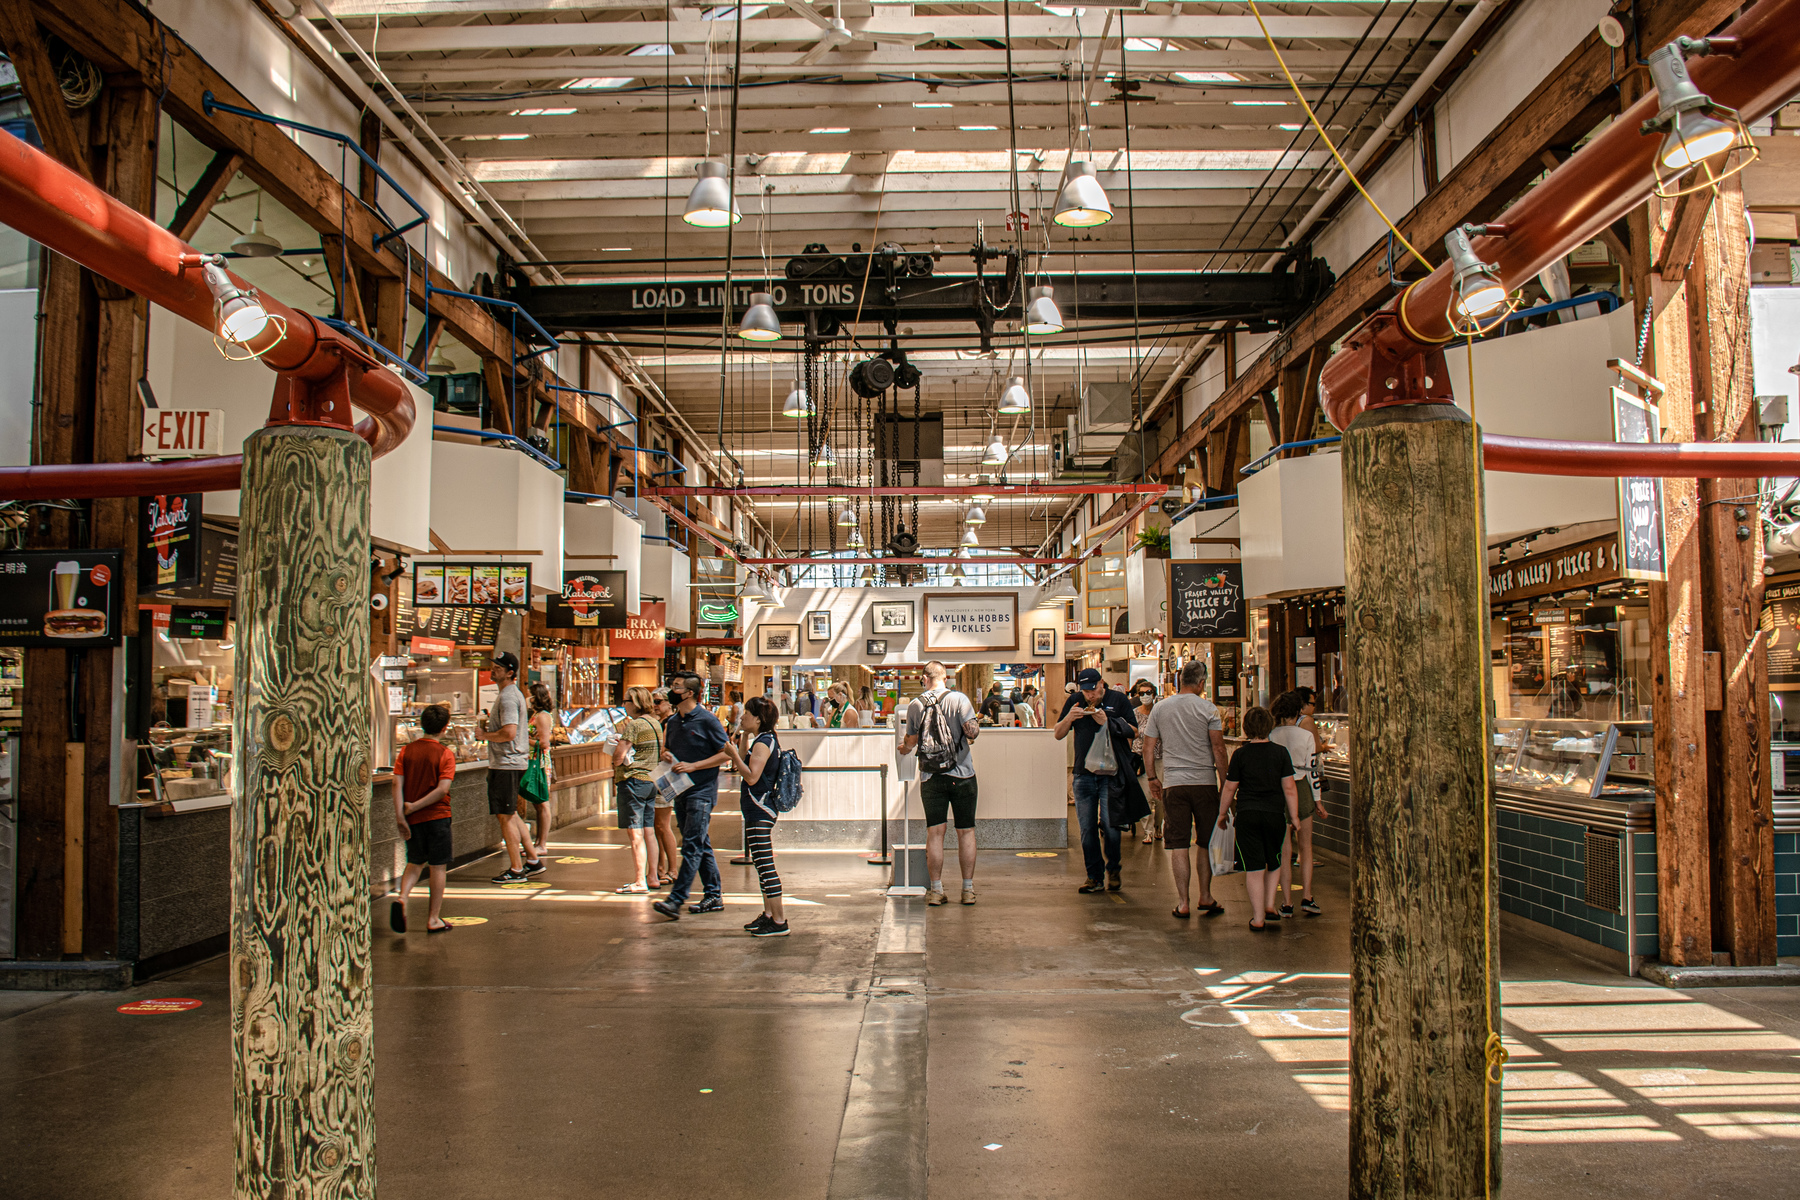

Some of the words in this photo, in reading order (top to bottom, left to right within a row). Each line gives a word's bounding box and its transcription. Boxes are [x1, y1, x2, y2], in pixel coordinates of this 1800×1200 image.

[632, 287, 686, 309] LOAD
[697, 287, 752, 307] LIMIT
[801, 284, 855, 305] TONS
[158, 411, 210, 450] EXIT
[1517, 562, 1551, 587] VALLEY
[1557, 551, 1591, 580] JUICE
[1597, 546, 1605, 569] &
[561, 583, 614, 599] Kaisereck
[1184, 589, 1208, 599] FRASER
[1209, 588, 1233, 596] VALLEY
[1185, 597, 1219, 610] JUICE
[1223, 596, 1230, 606] &
[933, 614, 966, 623] KAYLIN
[978, 614, 1010, 622] HOBBS
[1186, 609, 1217, 622] SALAD
[952, 624, 992, 633] PICKLES
[1066, 622, 1080, 632] EXIT
[615, 629, 660, 640] BREADS
